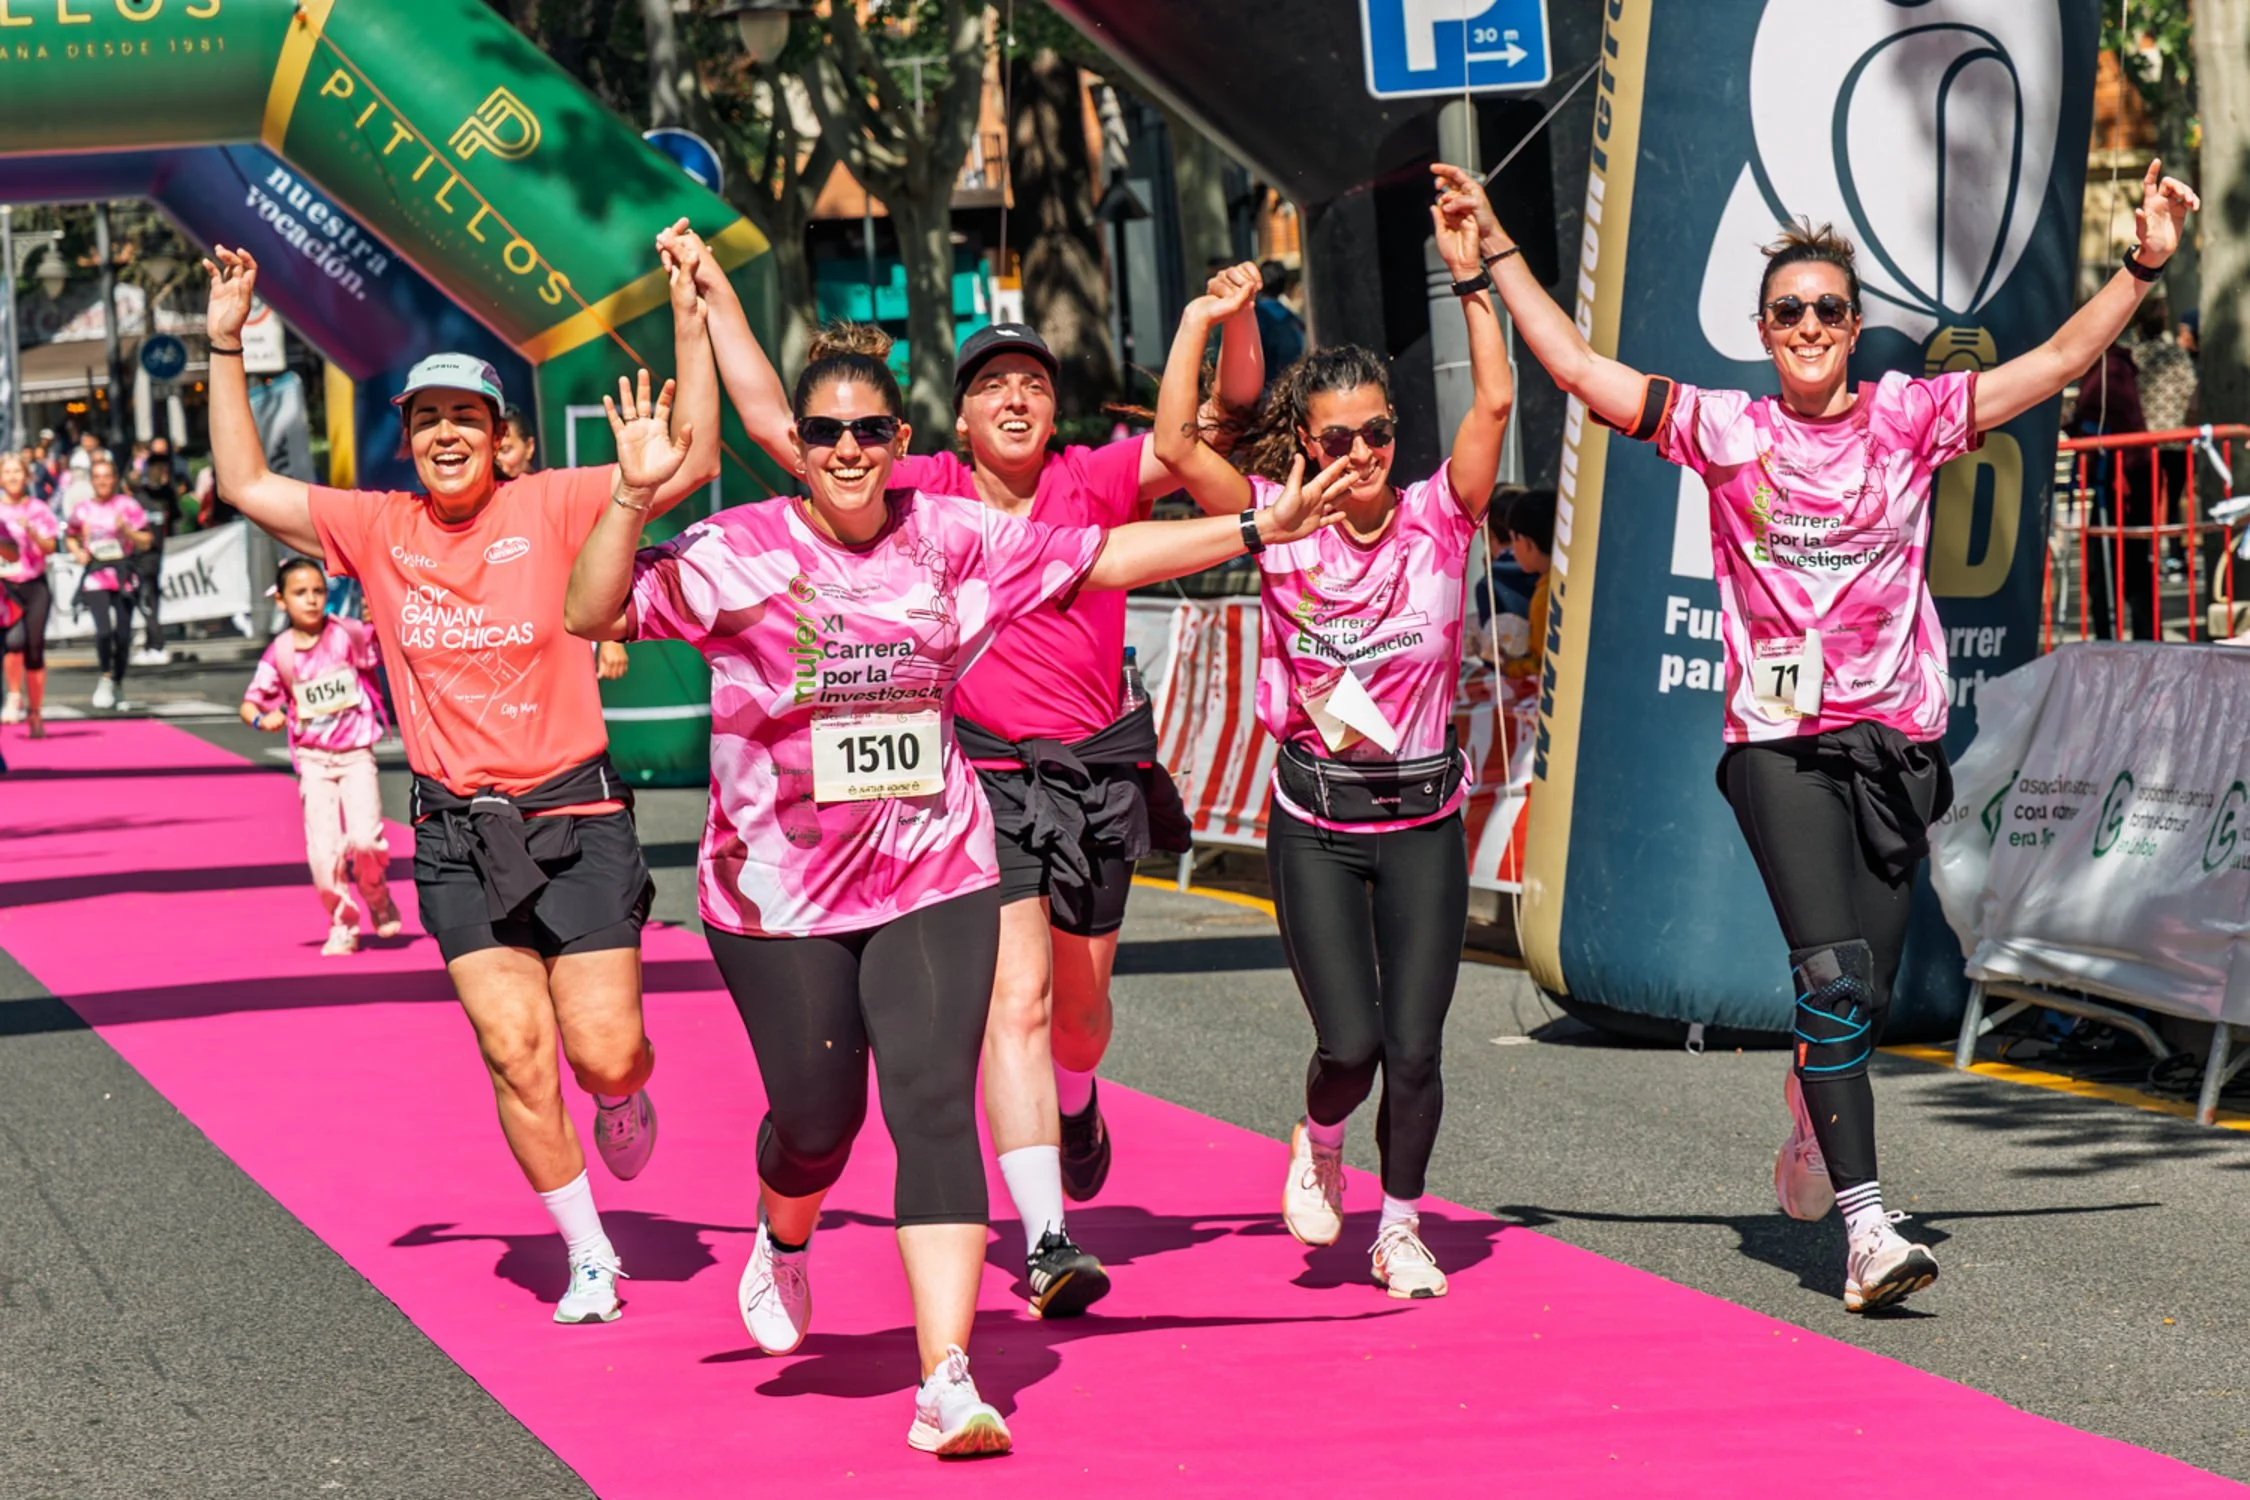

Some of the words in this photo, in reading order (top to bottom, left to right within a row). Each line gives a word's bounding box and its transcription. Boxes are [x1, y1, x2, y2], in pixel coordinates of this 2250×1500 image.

[1473, 28, 1498, 43] 30
[1503, 30, 1519, 41] m
[67, 41, 149, 58] DESDE
[170, 37, 224, 53] 1981
[320, 68, 571, 305] PITILLOS
[265, 166, 388, 277] nuestra
[245, 183, 366, 300] vocación.
[1771, 509, 1840, 528] Carrera
[1770, 532, 1799, 547] por
[1804, 533, 1820, 547] la
[405, 583, 449, 604] HOY
[401, 604, 484, 627] GANAN
[822, 614, 843, 634] XI
[402, 625, 437, 649] LAS
[441, 622, 534, 648] CHICAS
[1343, 632, 1358, 645] la
[788, 612, 825, 705] mujer
[823, 640, 912, 659] Carrera
[823, 670, 862, 689] por
[867, 665, 887, 682] la
[305, 679, 346, 704] 6154
[837, 733, 920, 773] 1510
